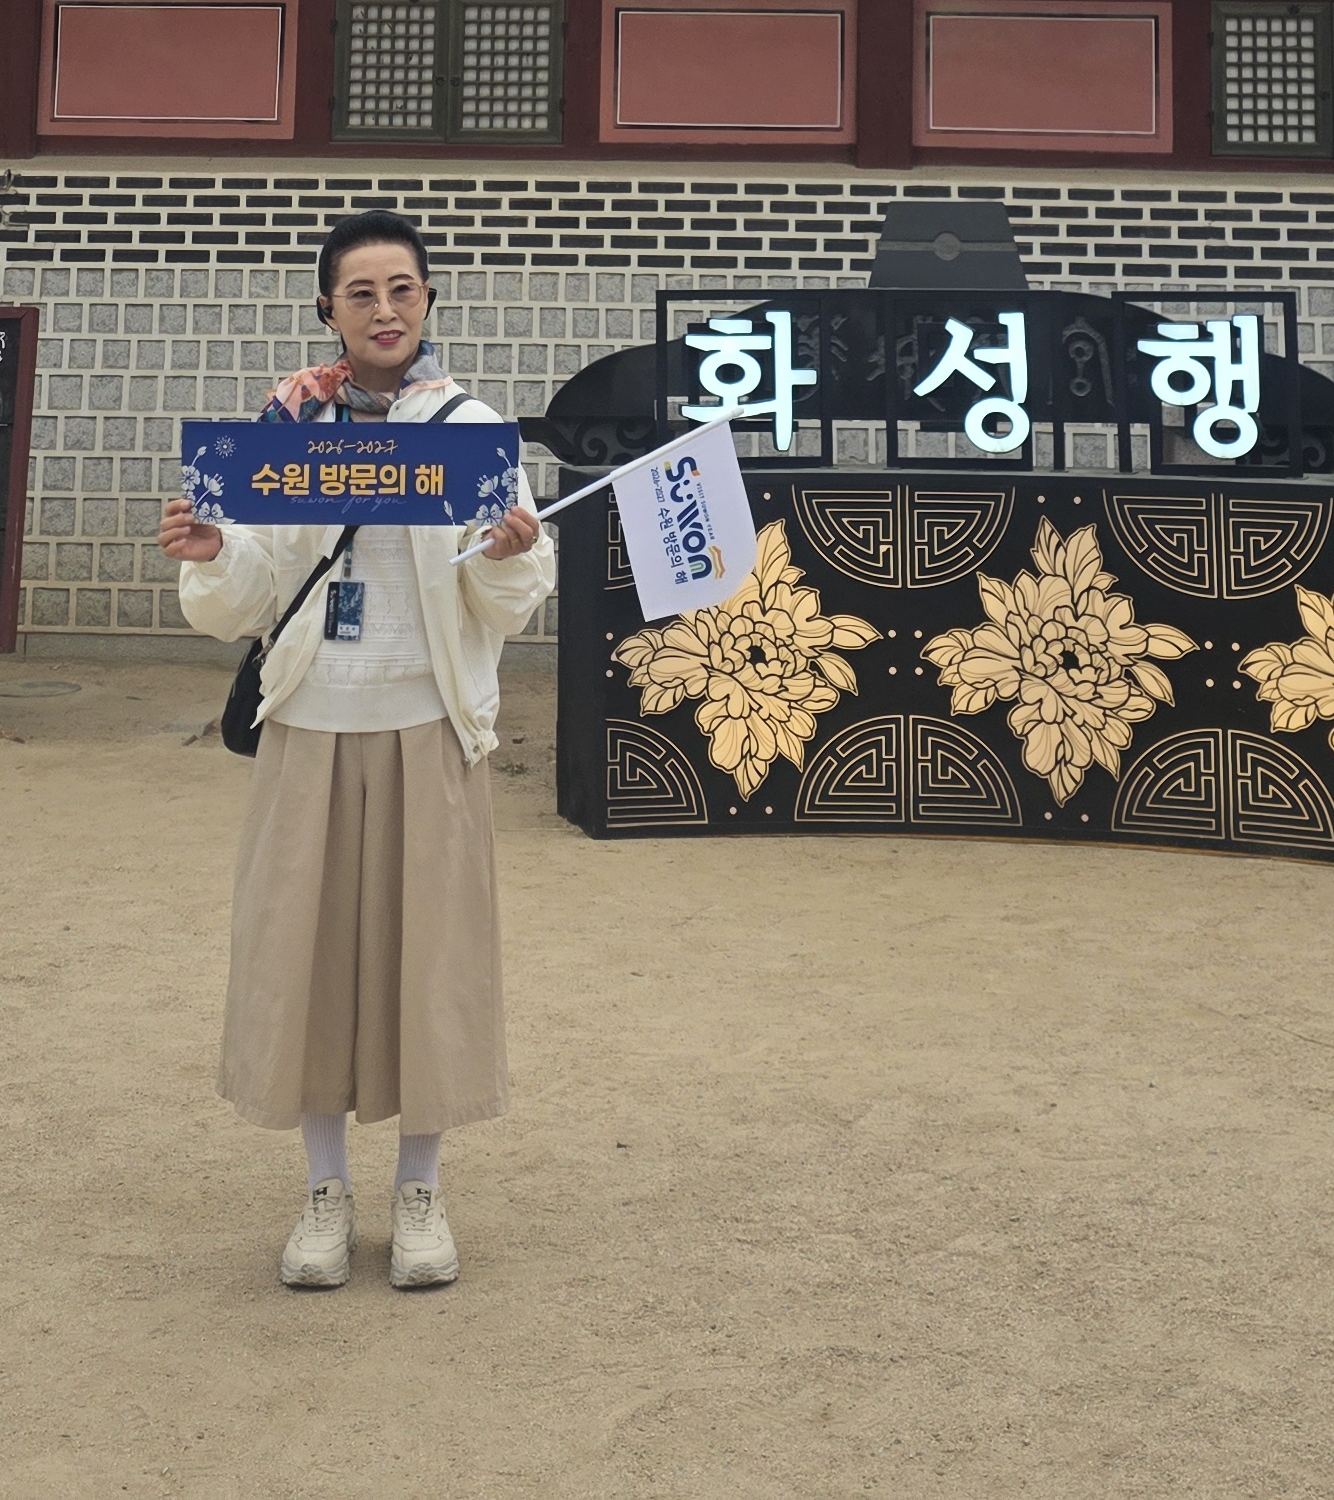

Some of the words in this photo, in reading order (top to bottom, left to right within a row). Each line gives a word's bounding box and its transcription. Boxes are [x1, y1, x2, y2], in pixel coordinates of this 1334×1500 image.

[307, 438, 399, 456] 2026-2027
[251, 462, 310, 497] 수원
[319, 463, 407, 497] 방문의
[414, 463, 445, 496] 해
[657, 507, 674, 532] 수원
[662, 531, 685, 569] 방문의
[674, 569, 689, 585] 해
